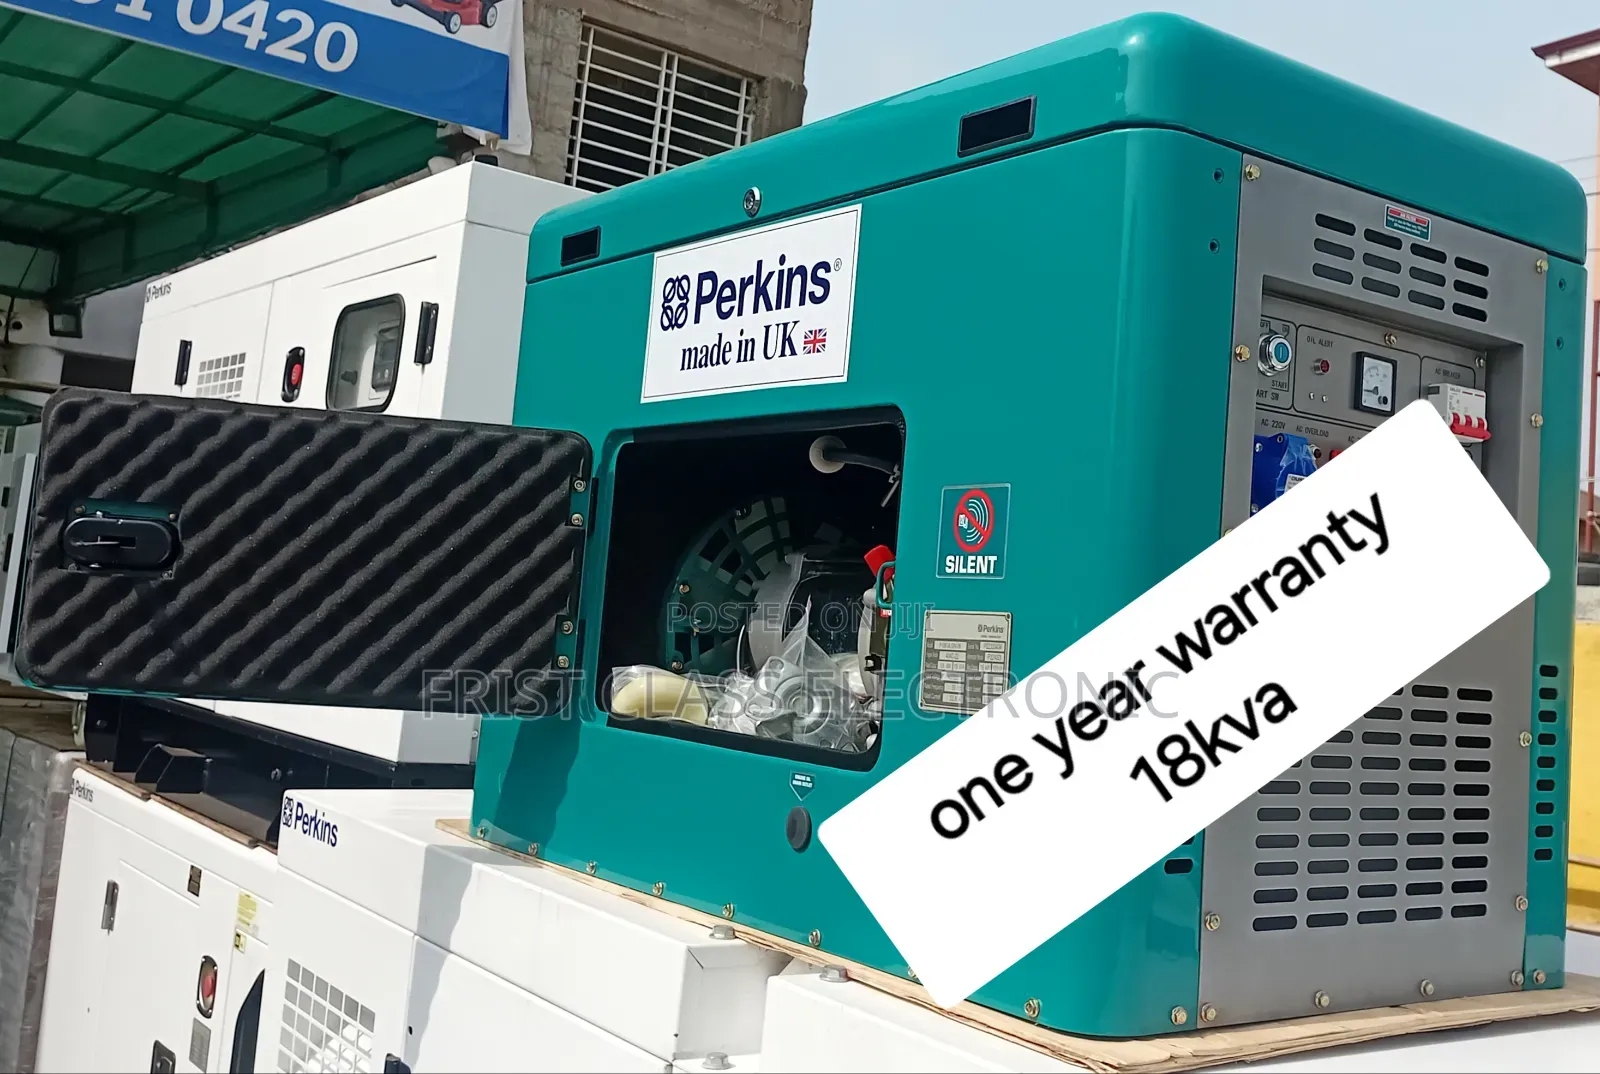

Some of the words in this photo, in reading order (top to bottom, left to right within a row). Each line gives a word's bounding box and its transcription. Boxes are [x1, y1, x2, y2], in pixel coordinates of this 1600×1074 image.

[680, 332, 732, 372] made
[736, 328, 756, 364] in
[763, 320, 801, 361] UK
[1306, 335, 1316, 345] OIL
[1318, 338, 1333, 348] ALERT
[1271, 379, 1287, 389] START
[1261, 418, 1269, 427] AC
[1272, 419, 1286, 430] 220V
[1295, 425, 1303, 433] AC
[1304, 426, 1330, 438] OVERLOAD
[945, 555, 998, 574] SILENT
[983, 624, 1004, 634] Perkins
[294, 801, 338, 848] Perkins
